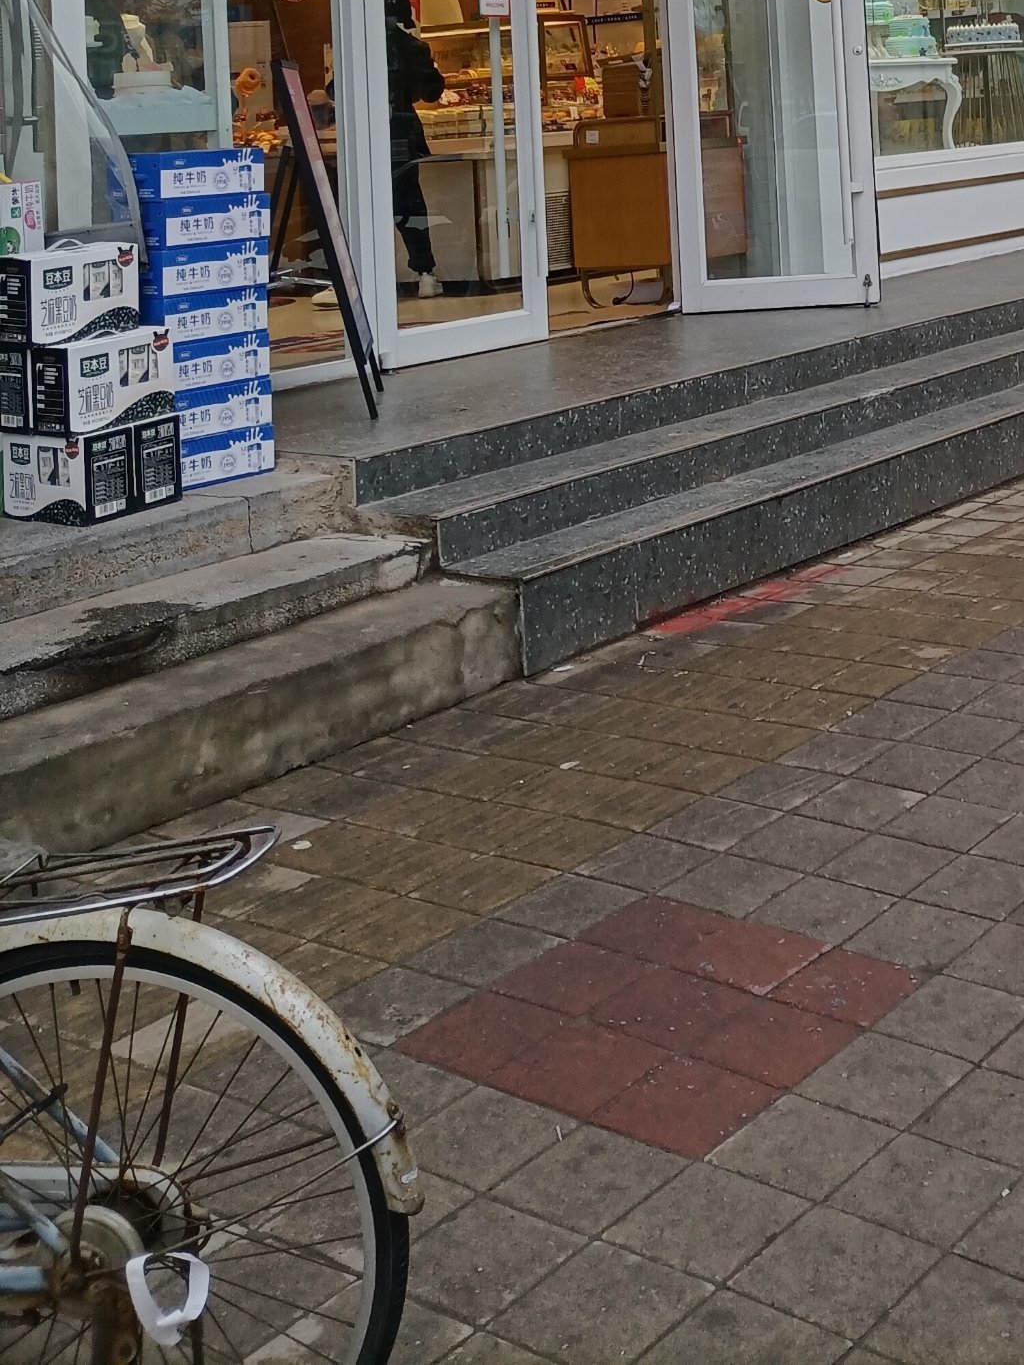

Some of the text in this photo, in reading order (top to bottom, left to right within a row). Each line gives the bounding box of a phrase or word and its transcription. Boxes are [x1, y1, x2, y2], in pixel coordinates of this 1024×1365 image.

[172, 170, 207, 186] 纯牛奶
[180, 216, 214, 233] 纯牛奶
[45, 270, 71, 285] 豆本豆
[175, 265, 211, 282] 纯牛奶
[40, 294, 77, 327] 芝麻黑豆奶
[177, 312, 211, 330] 纯牛奶
[82, 356, 108, 373] 豆本豆
[178, 359, 213, 378] 纯牛奶
[78, 381, 115, 415] 芝麻黑豆奶
[11, 445, 30, 460] 豆本豆
